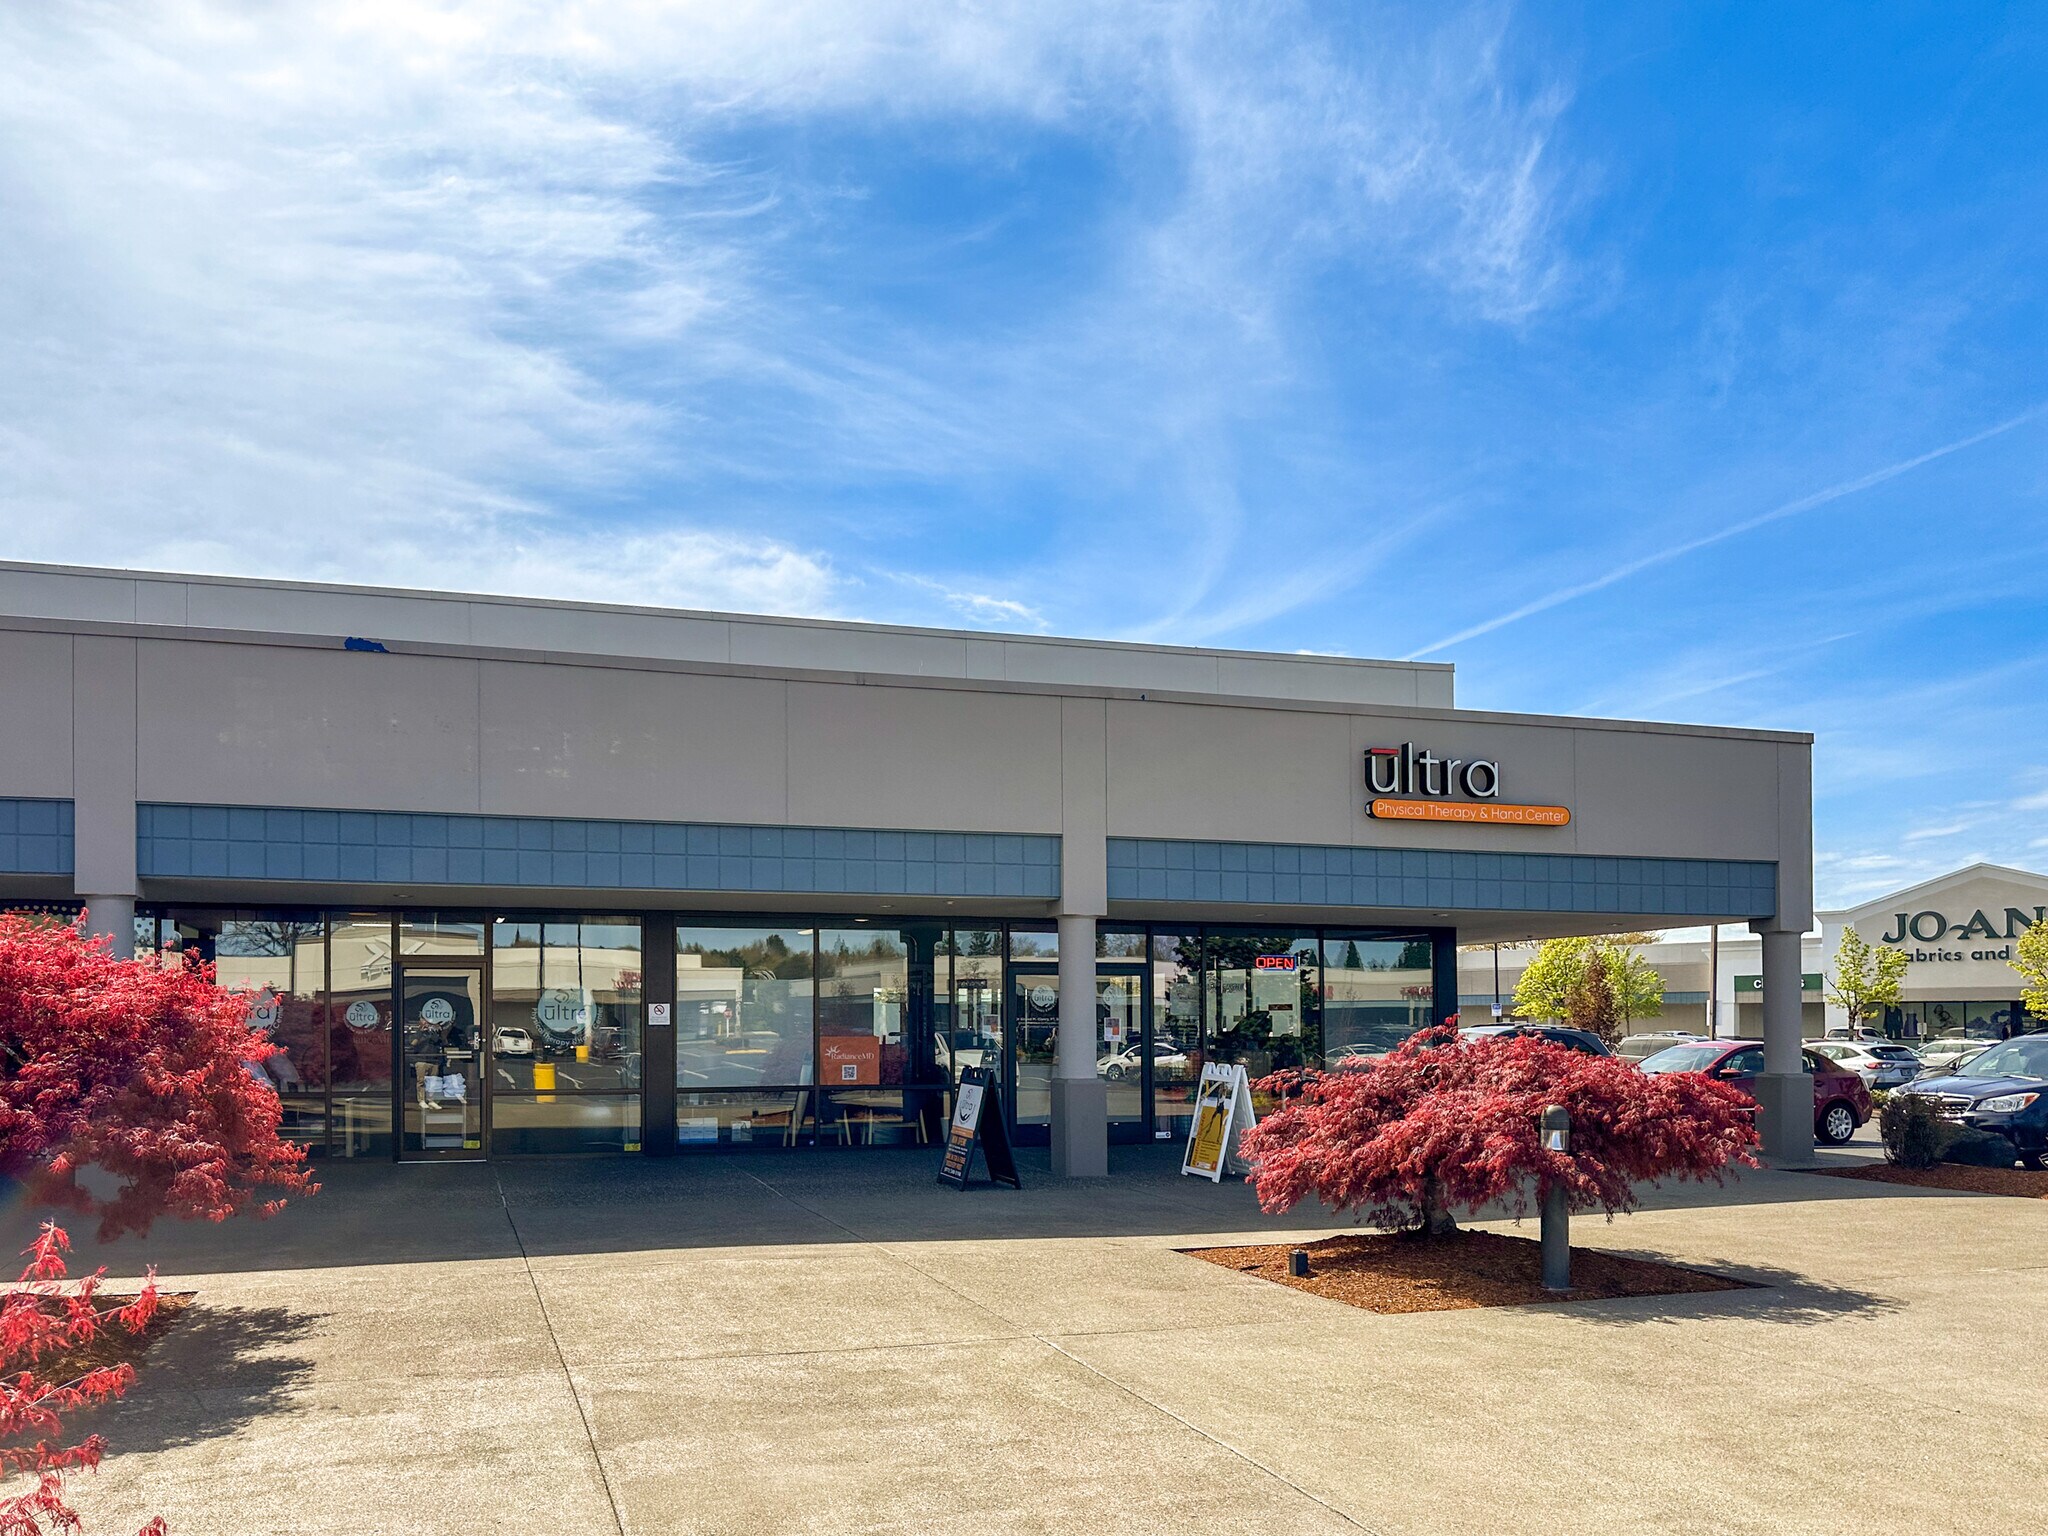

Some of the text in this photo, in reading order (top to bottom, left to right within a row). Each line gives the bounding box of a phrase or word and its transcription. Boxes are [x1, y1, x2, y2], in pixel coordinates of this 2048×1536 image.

[1377, 801, 1565, 822] Physical Therapy & Hand Center
[1255, 957, 1295, 969] OPEN
[1897, 944, 2010, 963] abrics and
[531, 1007, 546, 1034] Physical
[543, 1031, 570, 1046] Therapy
[831, 1052, 875, 1060] RadianceMD
